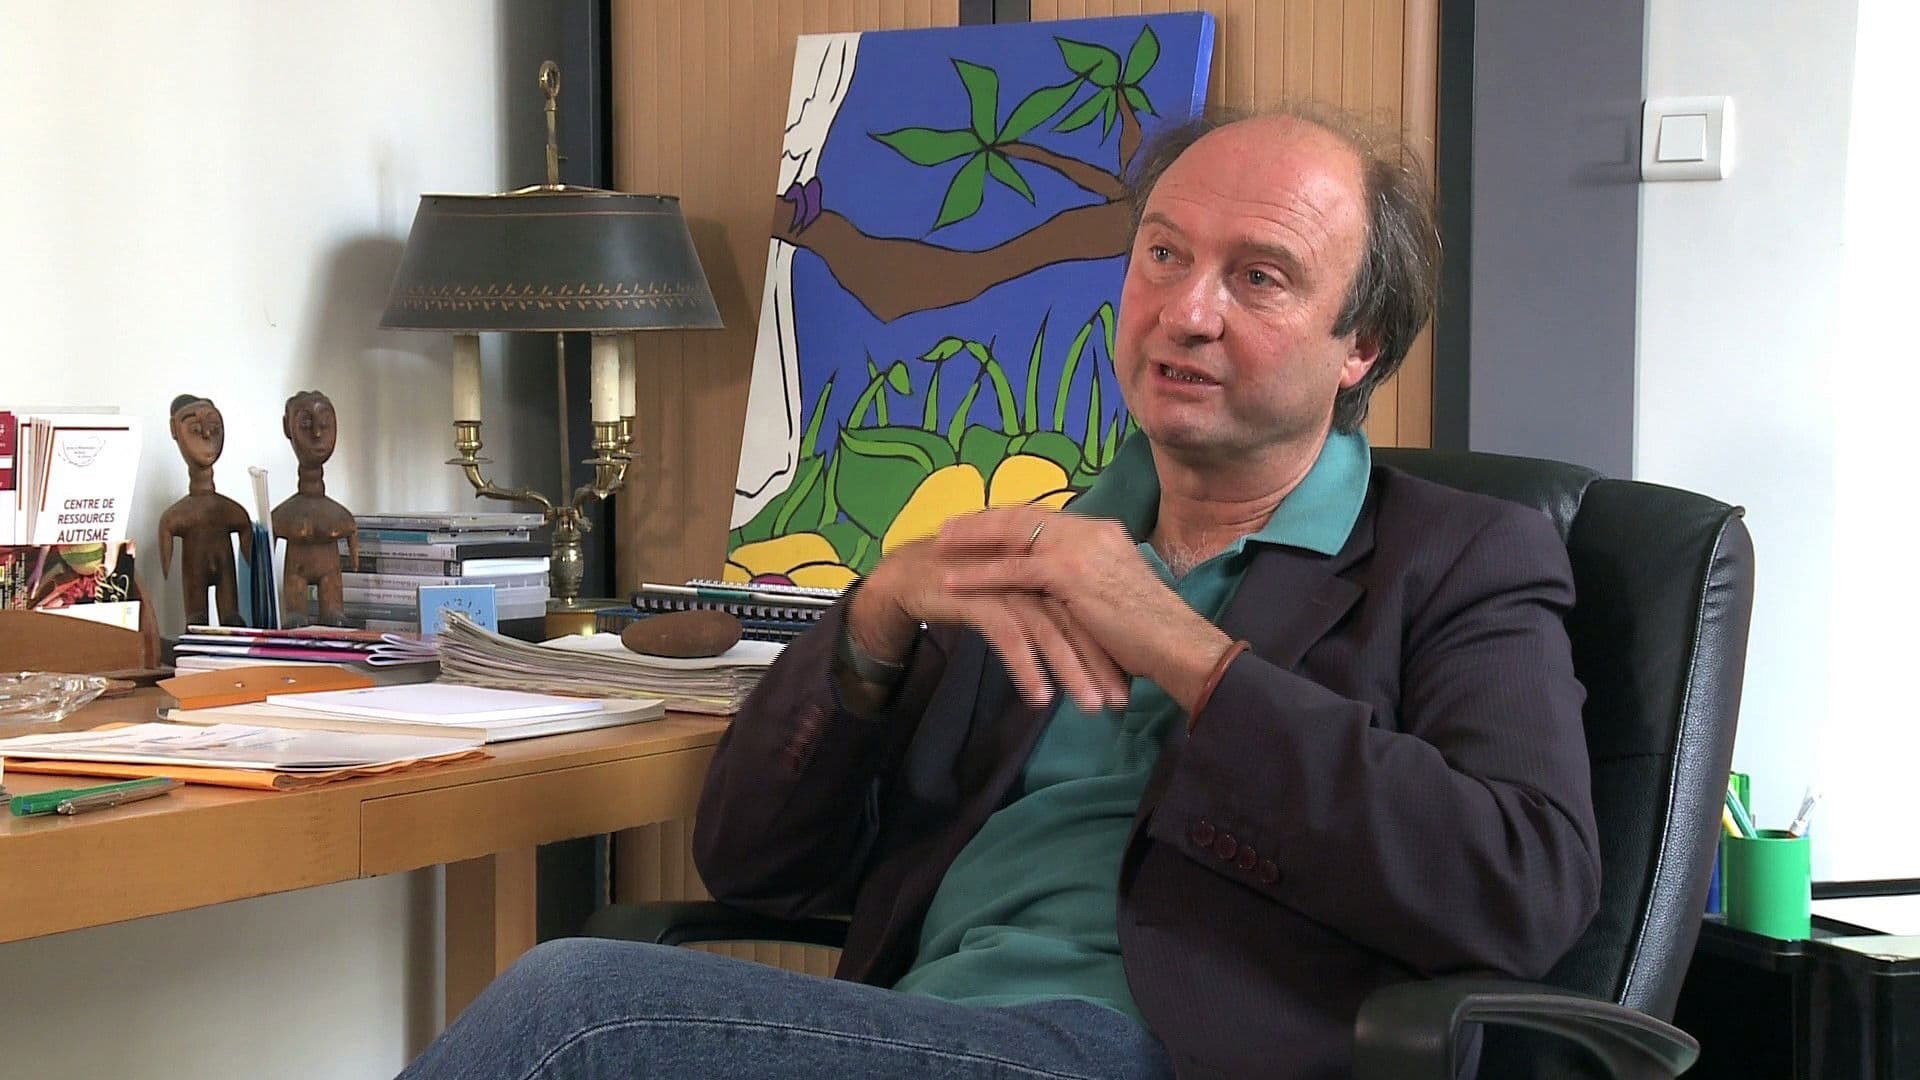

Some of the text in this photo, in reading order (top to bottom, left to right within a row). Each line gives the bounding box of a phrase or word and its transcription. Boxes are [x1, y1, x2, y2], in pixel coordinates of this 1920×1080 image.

[63, 498, 115, 510] CENTRE DE
[57, 512, 115, 525] RESSOURCES
[57, 528, 110, 543] AUTISME
